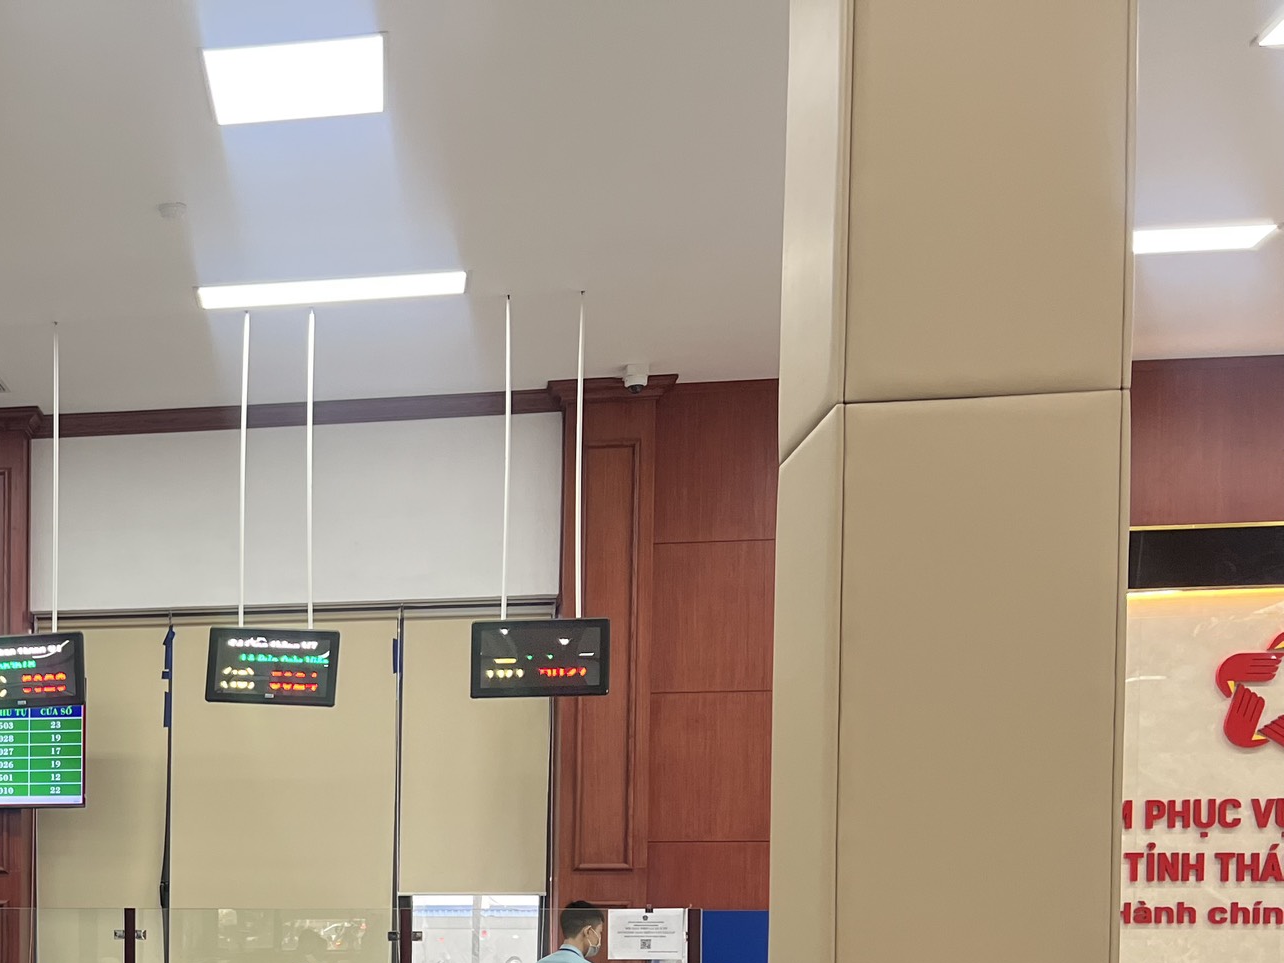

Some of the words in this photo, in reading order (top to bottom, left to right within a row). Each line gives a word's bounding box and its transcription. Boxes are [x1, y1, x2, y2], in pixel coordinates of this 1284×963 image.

[40, 706, 58, 715] CỬA
[61, 705, 72, 715] SỐ
[1145, 799, 1242, 838] PHỤC
[1124, 843, 1205, 882] TỈNH
[1214, 843, 1284, 882] THÁ
[1208, 901, 1283, 925] chín
